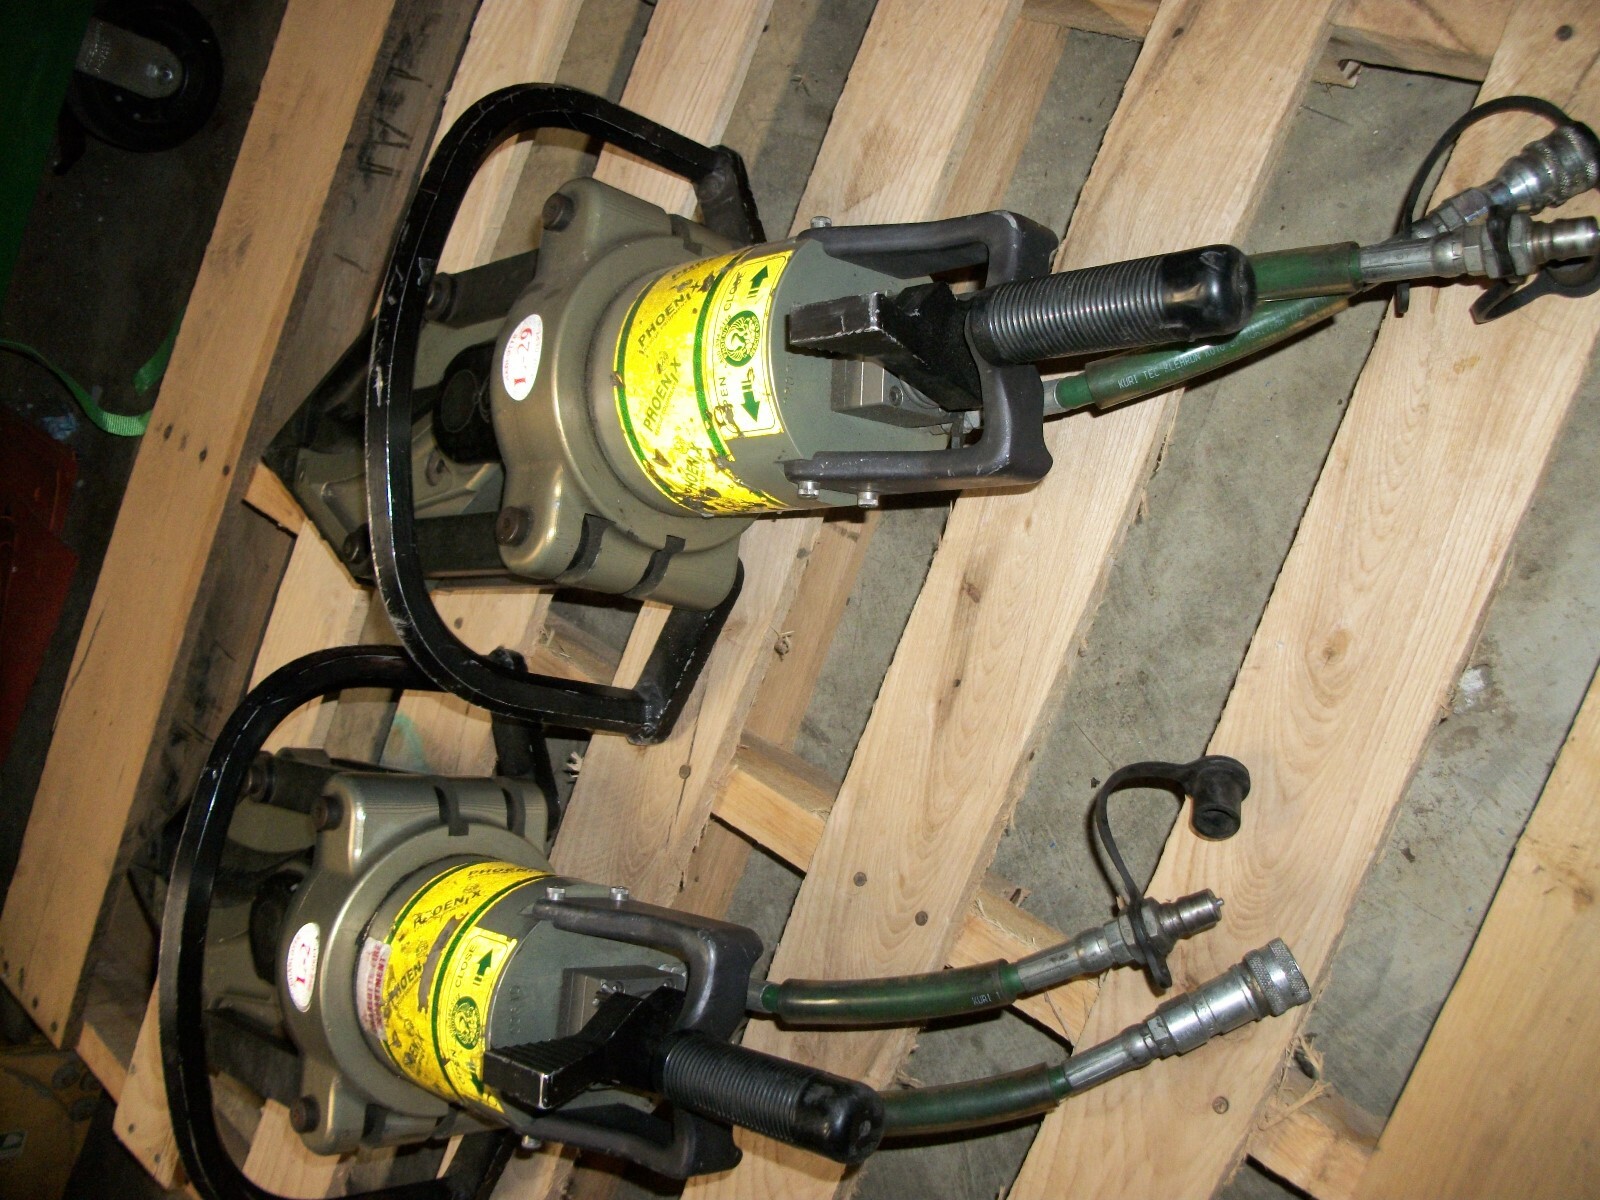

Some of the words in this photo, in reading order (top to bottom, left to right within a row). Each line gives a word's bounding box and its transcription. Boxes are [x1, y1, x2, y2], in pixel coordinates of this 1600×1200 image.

[637, 281, 701, 348] PHOENIX
[643, 356, 682, 433] PHOENIX
[1117, 376, 1139, 389] KURI
[1143, 367, 1161, 380] TEC
[455, 945, 476, 988] CLOSE
[971, 993, 992, 1006] KURI
